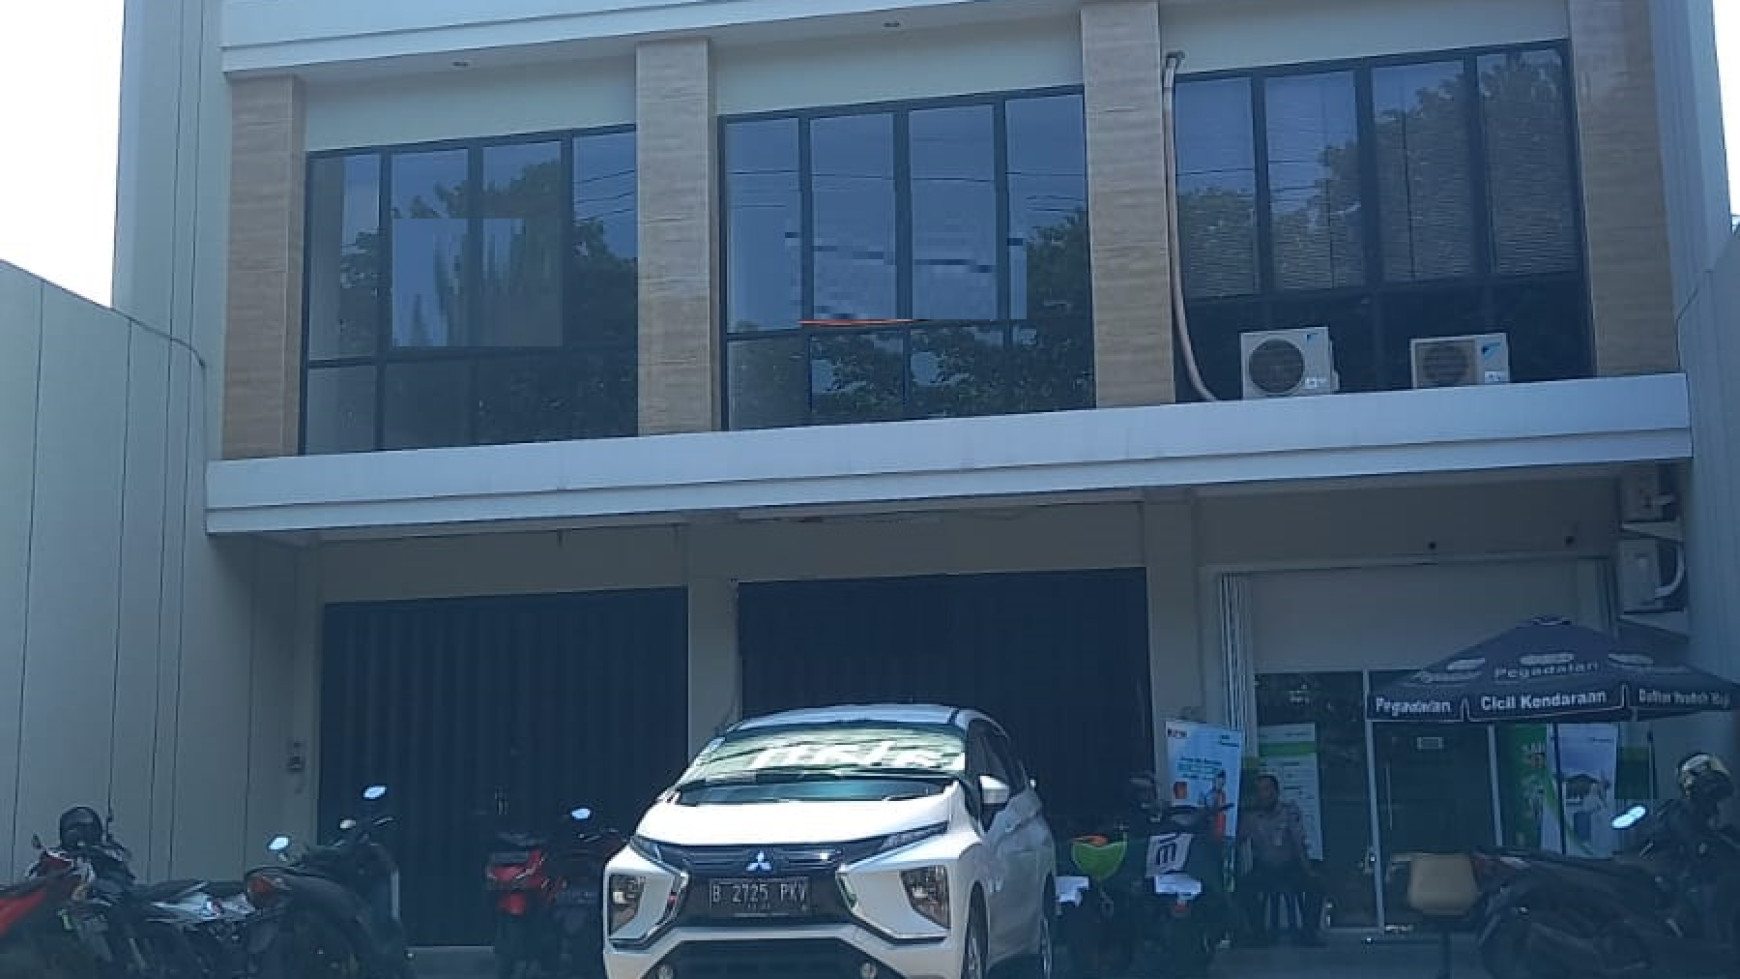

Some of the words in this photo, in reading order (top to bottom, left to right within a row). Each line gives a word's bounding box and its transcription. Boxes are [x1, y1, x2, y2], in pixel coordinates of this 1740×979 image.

[1481, 695, 1516, 711] Cicil
[1521, 690, 1607, 710] Kendaraan
[712, 885, 720, 902] B
[732, 884, 768, 902] 2725
